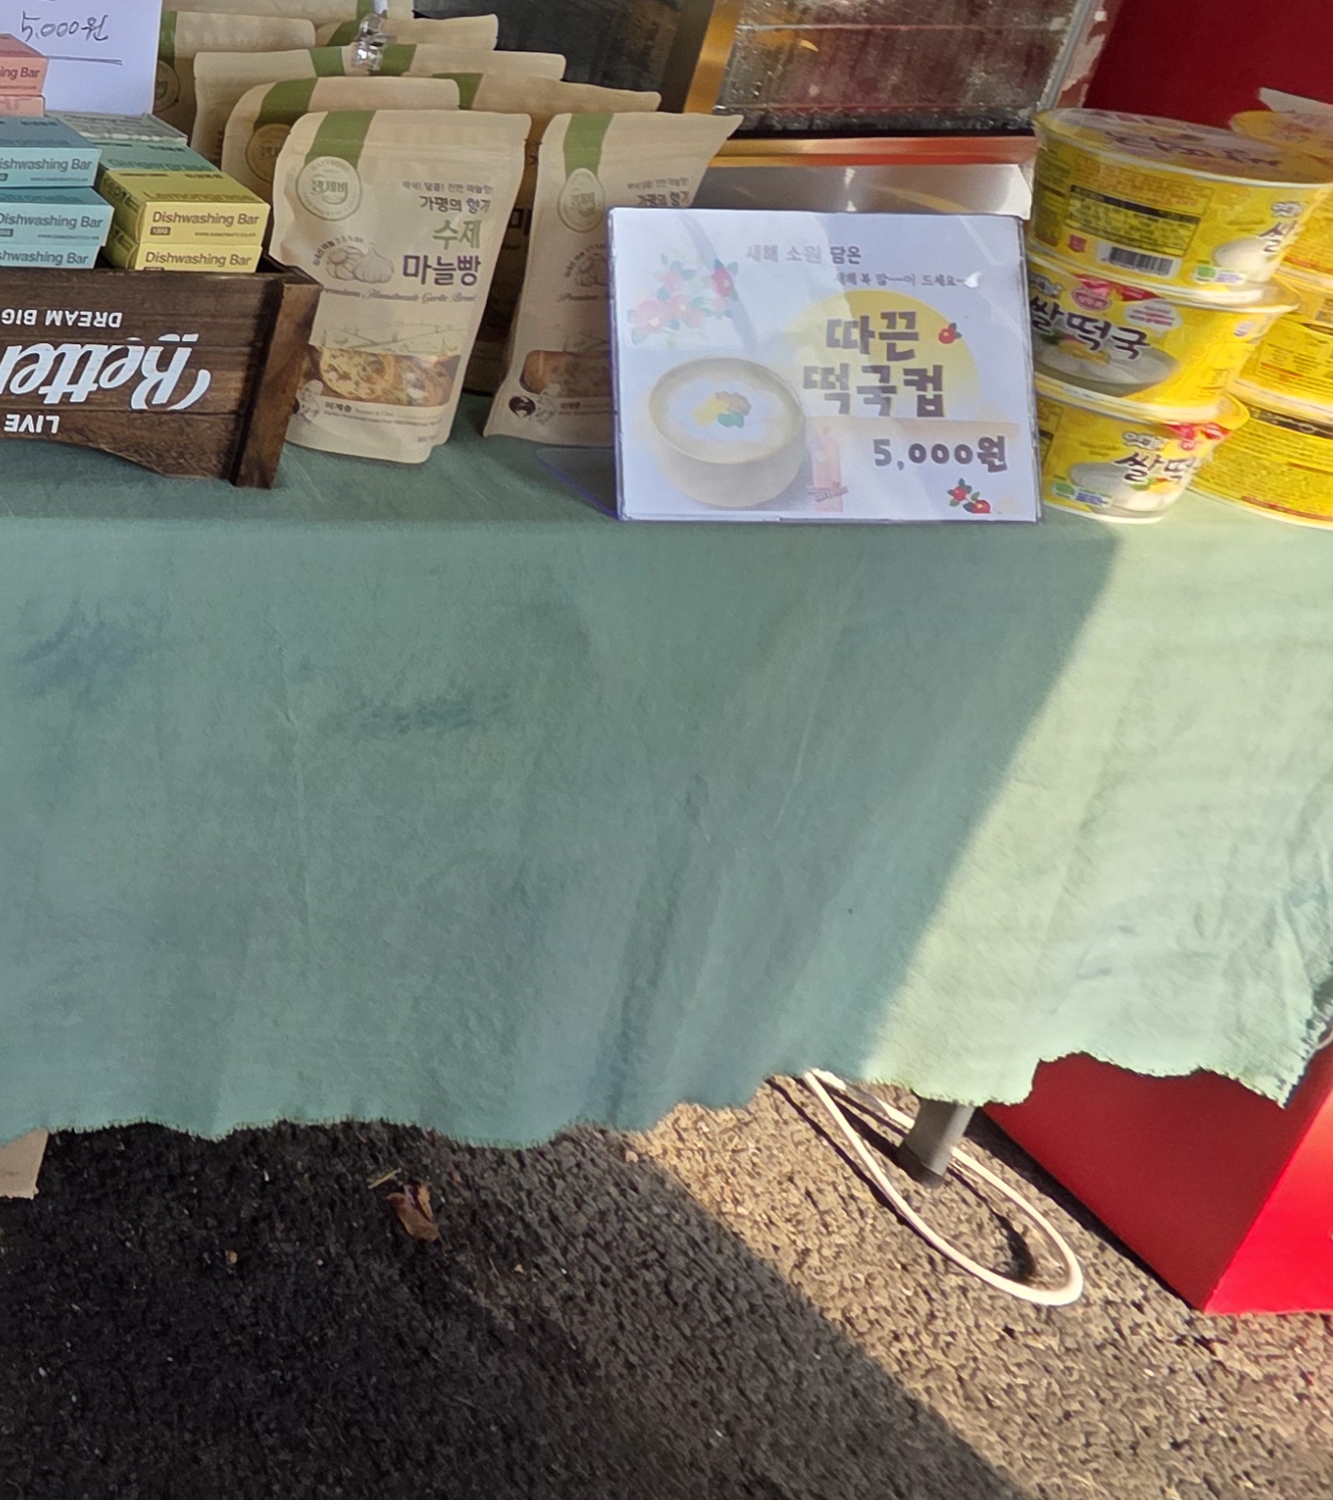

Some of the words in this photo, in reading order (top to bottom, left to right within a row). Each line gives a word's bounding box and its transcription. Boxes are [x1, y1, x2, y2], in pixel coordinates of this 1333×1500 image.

[20, 66, 41, 78] Bar
[71, 159, 93, 171] Bar
[420, 195, 463, 213] 가평의
[465, 197, 492, 214] 향기
[80, 216, 104, 229] Bar
[152, 211, 234, 226] Dishwashing
[237, 213, 260, 226] Bar
[432, 219, 483, 250] 수제
[66, 252, 89, 265] Bar
[145, 251, 226, 267] Dishwashing
[229, 254, 252, 266] Bar
[785, 245, 822, 265] 소원
[829, 245, 862, 266] 담은
[402, 255, 482, 287] 마늘빵
[44, 310, 123, 329] DREAM
[1029, 295, 1152, 361] 쌀떡국
[825, 310, 920, 362] 따끈
[801, 361, 946, 419] 떡국컵
[3, 414, 59, 435] LIVE
[872, 435, 1009, 474] 5,000원
